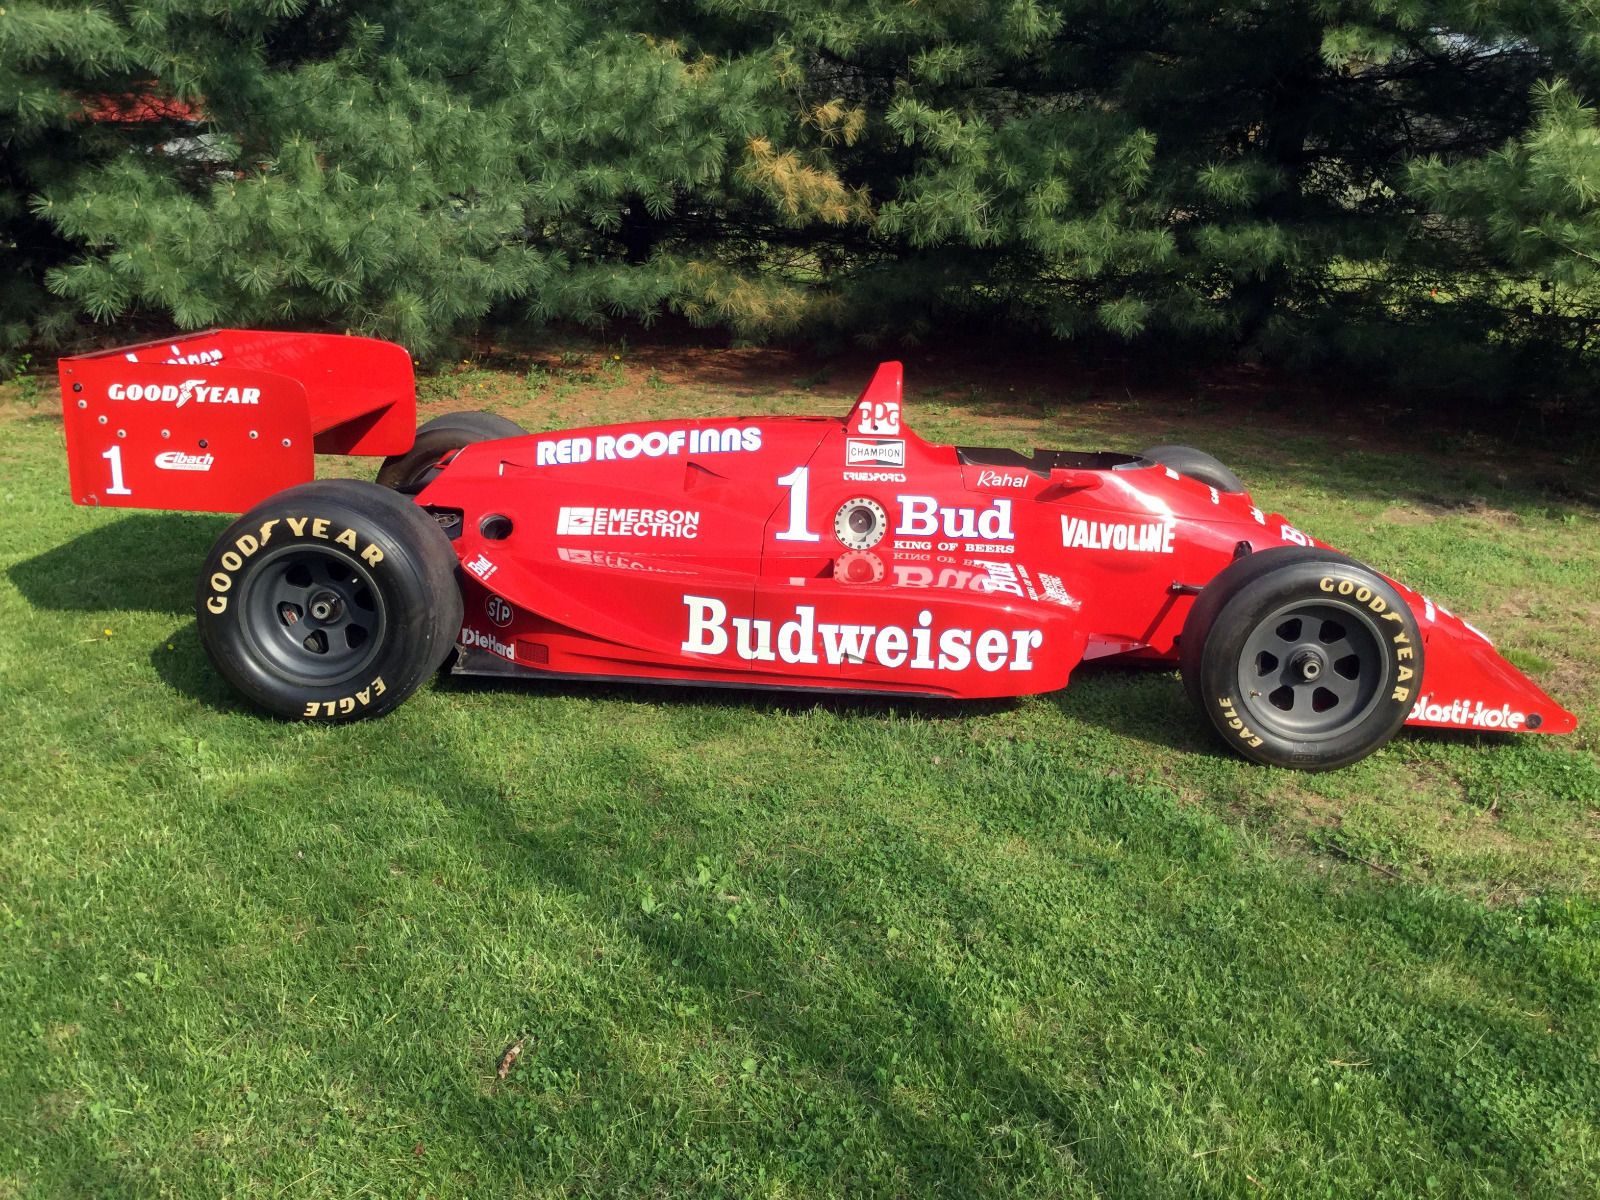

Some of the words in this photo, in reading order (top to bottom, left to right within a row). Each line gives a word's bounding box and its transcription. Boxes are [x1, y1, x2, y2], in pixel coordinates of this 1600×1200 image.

[108, 379, 261, 408] GOODYEAR
[155, 451, 215, 471] Eibach
[536, 438, 592, 466] RED
[596, 430, 686, 460] ROOF
[850, 447, 901, 458] CHAMPION
[102, 445, 132, 495] 1
[976, 470, 1028, 488] Rahal
[595, 508, 700, 525] EMERSON
[775, 466, 820, 542] 1
[895, 494, 1015, 540] Bud
[593, 522, 698, 539] ELECTRIC
[893, 540, 932, 550] KING
[937, 541, 959, 551] OF
[965, 543, 1015, 554] BEERS
[1060, 514, 1177, 554] VALVOLINE
[206, 517, 385, 615] GOODYEAR
[467, 554, 493, 577] Bud
[488, 597, 511, 622] STP
[461, 628, 515, 660] DieHard
[681, 594, 1043, 673] Budweiser
[1319, 577, 1415, 702] GOODYEAR
[303, 676, 386, 717] EAGLE
[1217, 696, 1265, 749] EAGLE
